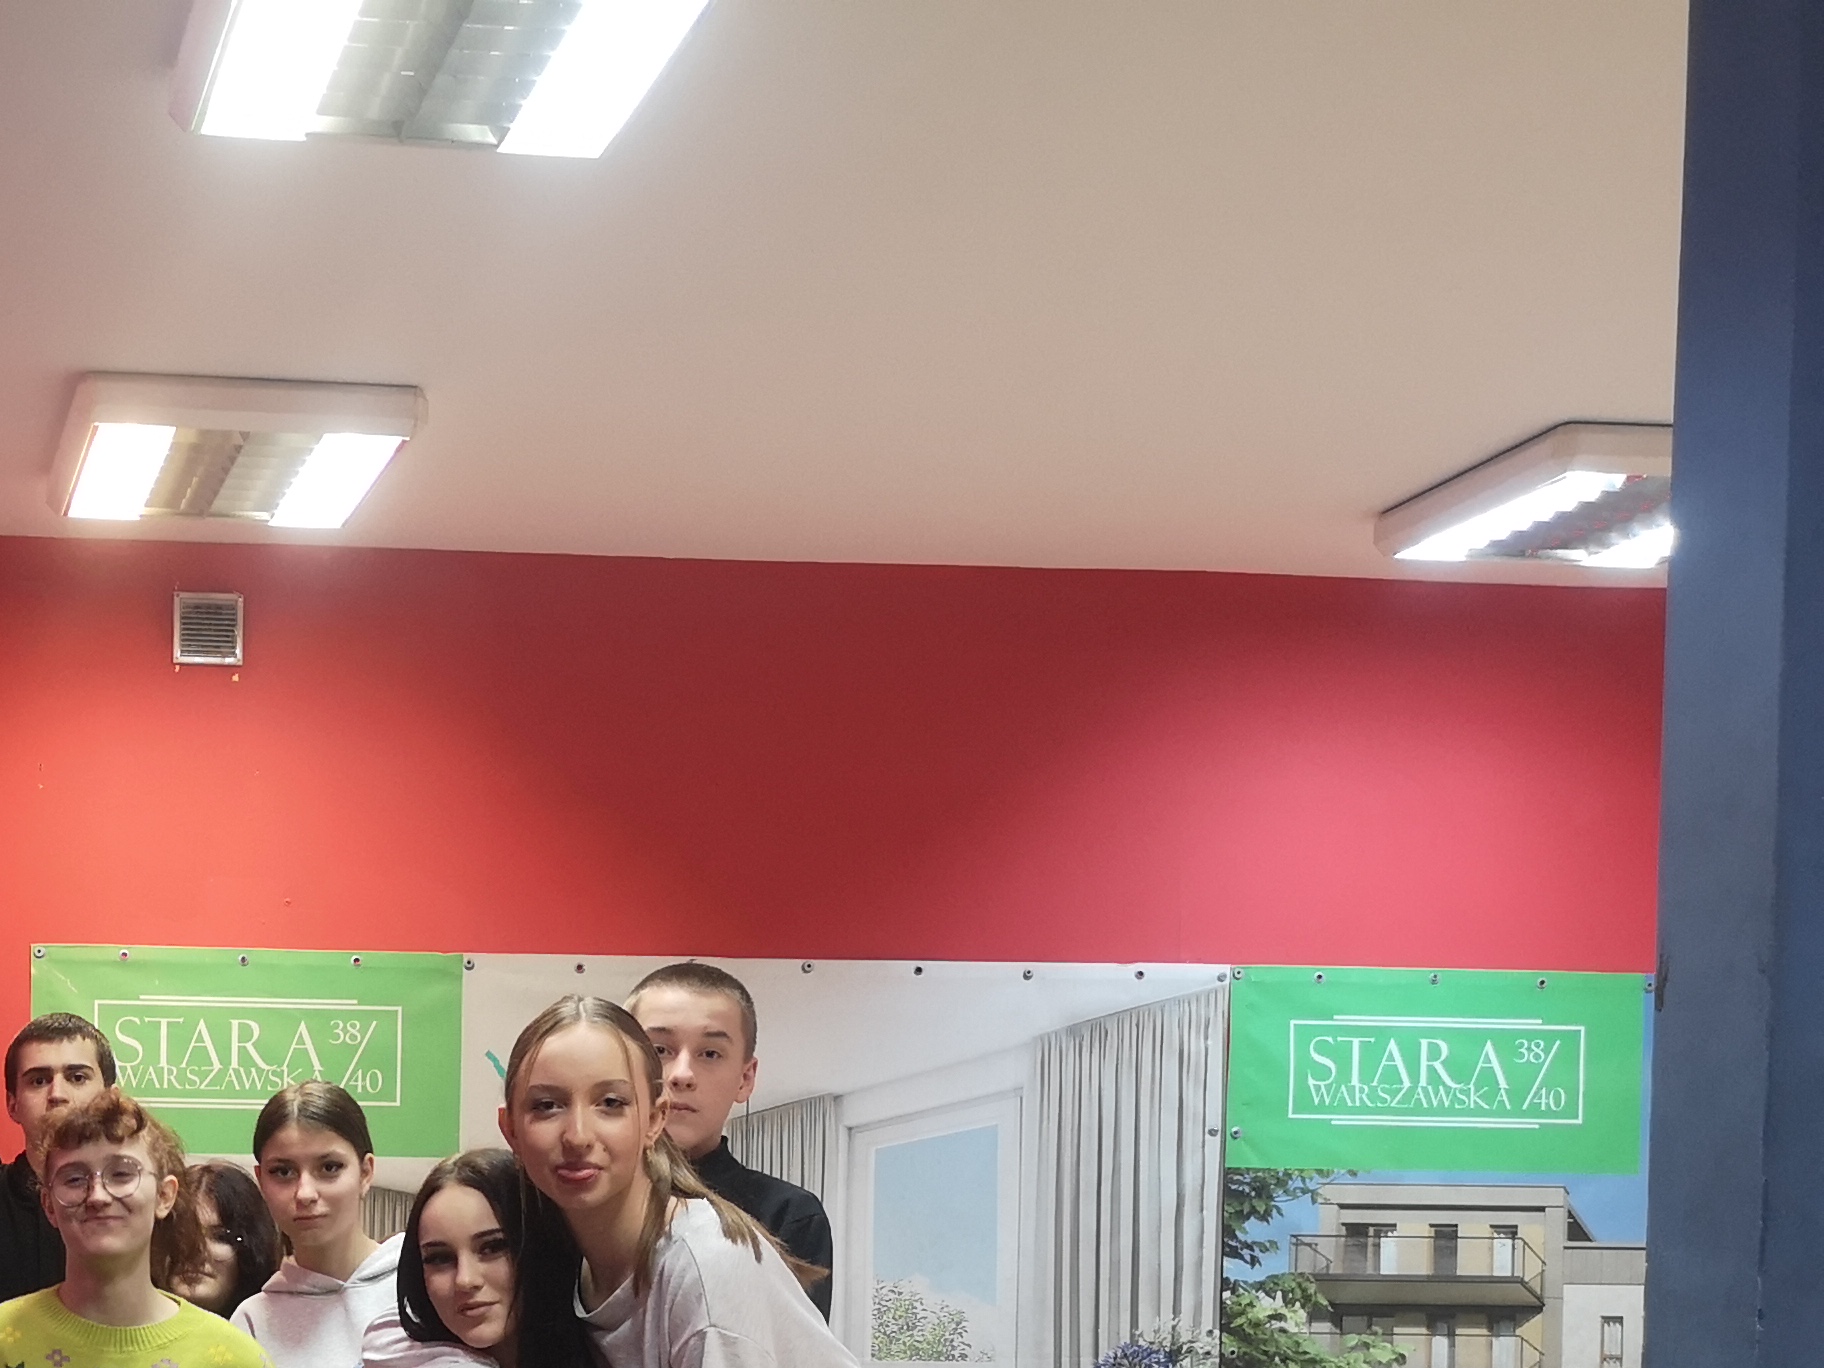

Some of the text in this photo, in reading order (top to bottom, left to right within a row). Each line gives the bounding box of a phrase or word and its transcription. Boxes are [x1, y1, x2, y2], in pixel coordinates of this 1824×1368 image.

[113, 1016, 324, 1071] STARA
[1307, 1035, 1510, 1089] STARA
[1307, 1083, 1512, 1110] WARSZAWSKA
